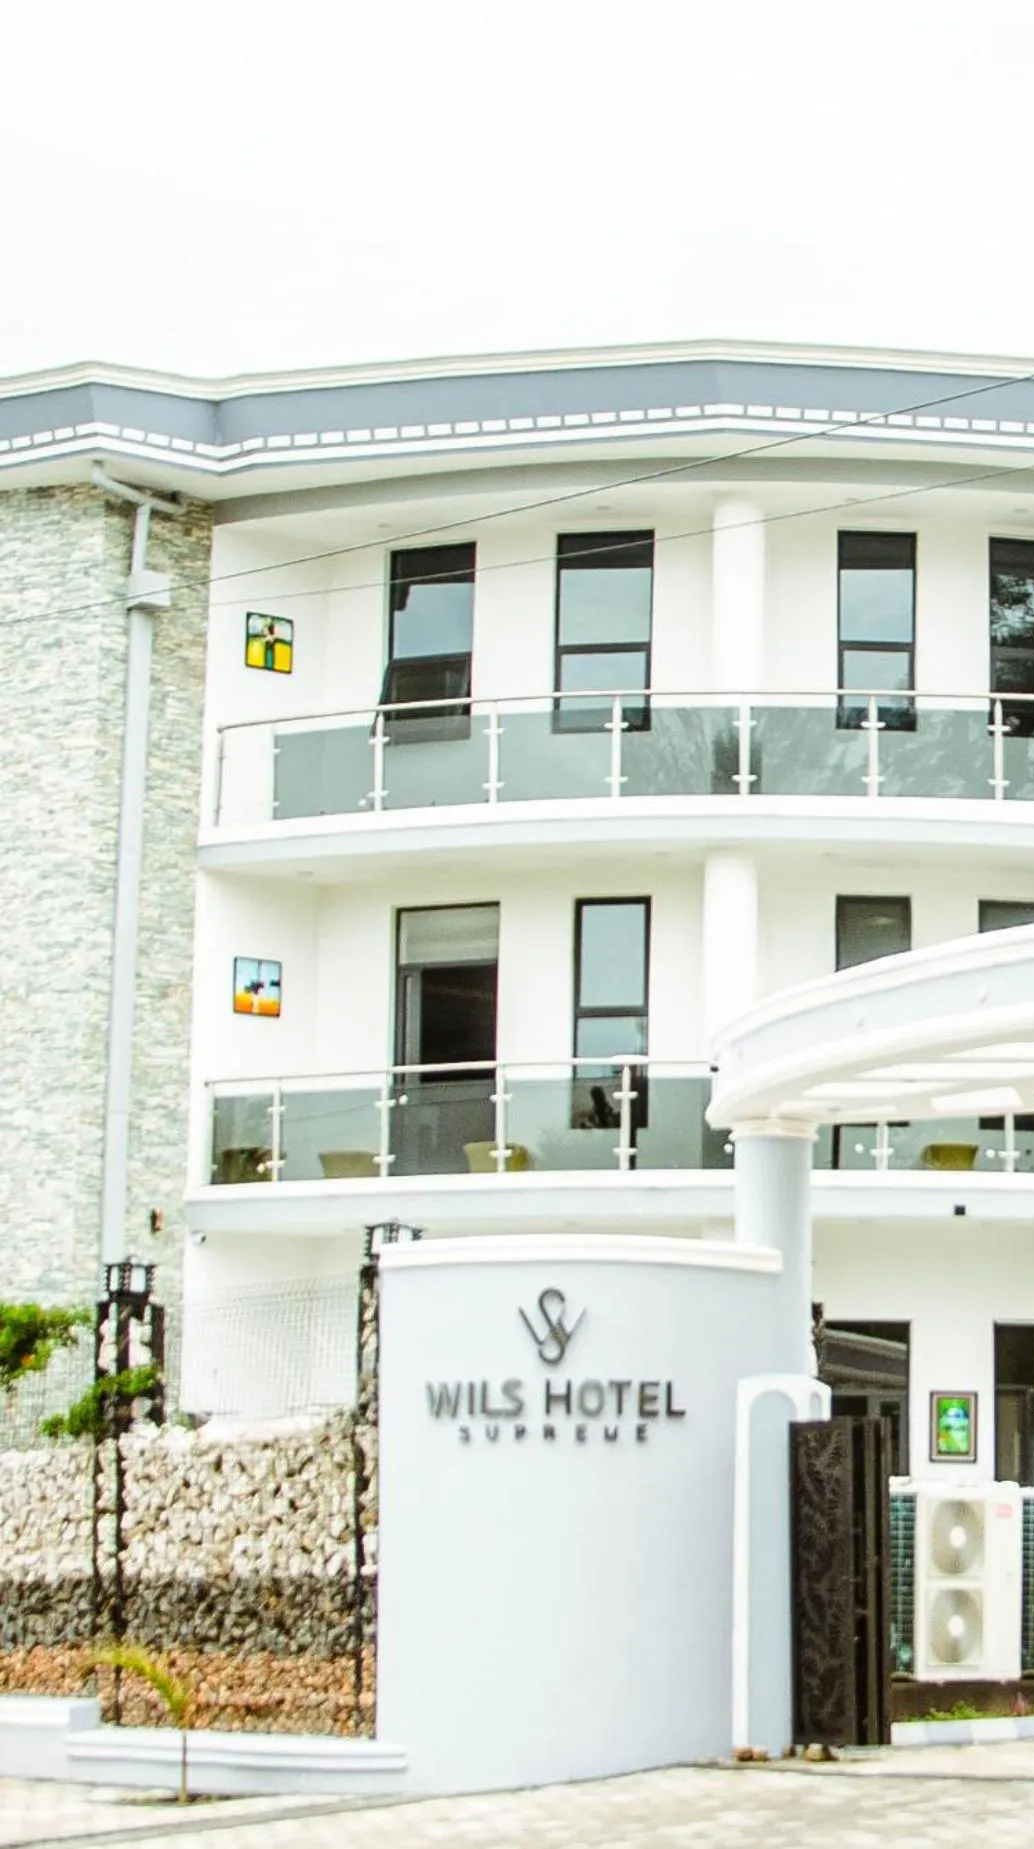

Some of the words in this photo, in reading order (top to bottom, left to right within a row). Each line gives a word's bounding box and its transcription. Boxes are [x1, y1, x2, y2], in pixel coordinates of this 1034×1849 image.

[426, 1378, 524, 1419] WILS
[545, 1379, 687, 1418] HOTEL
[459, 1423, 650, 1444] SUPREME
